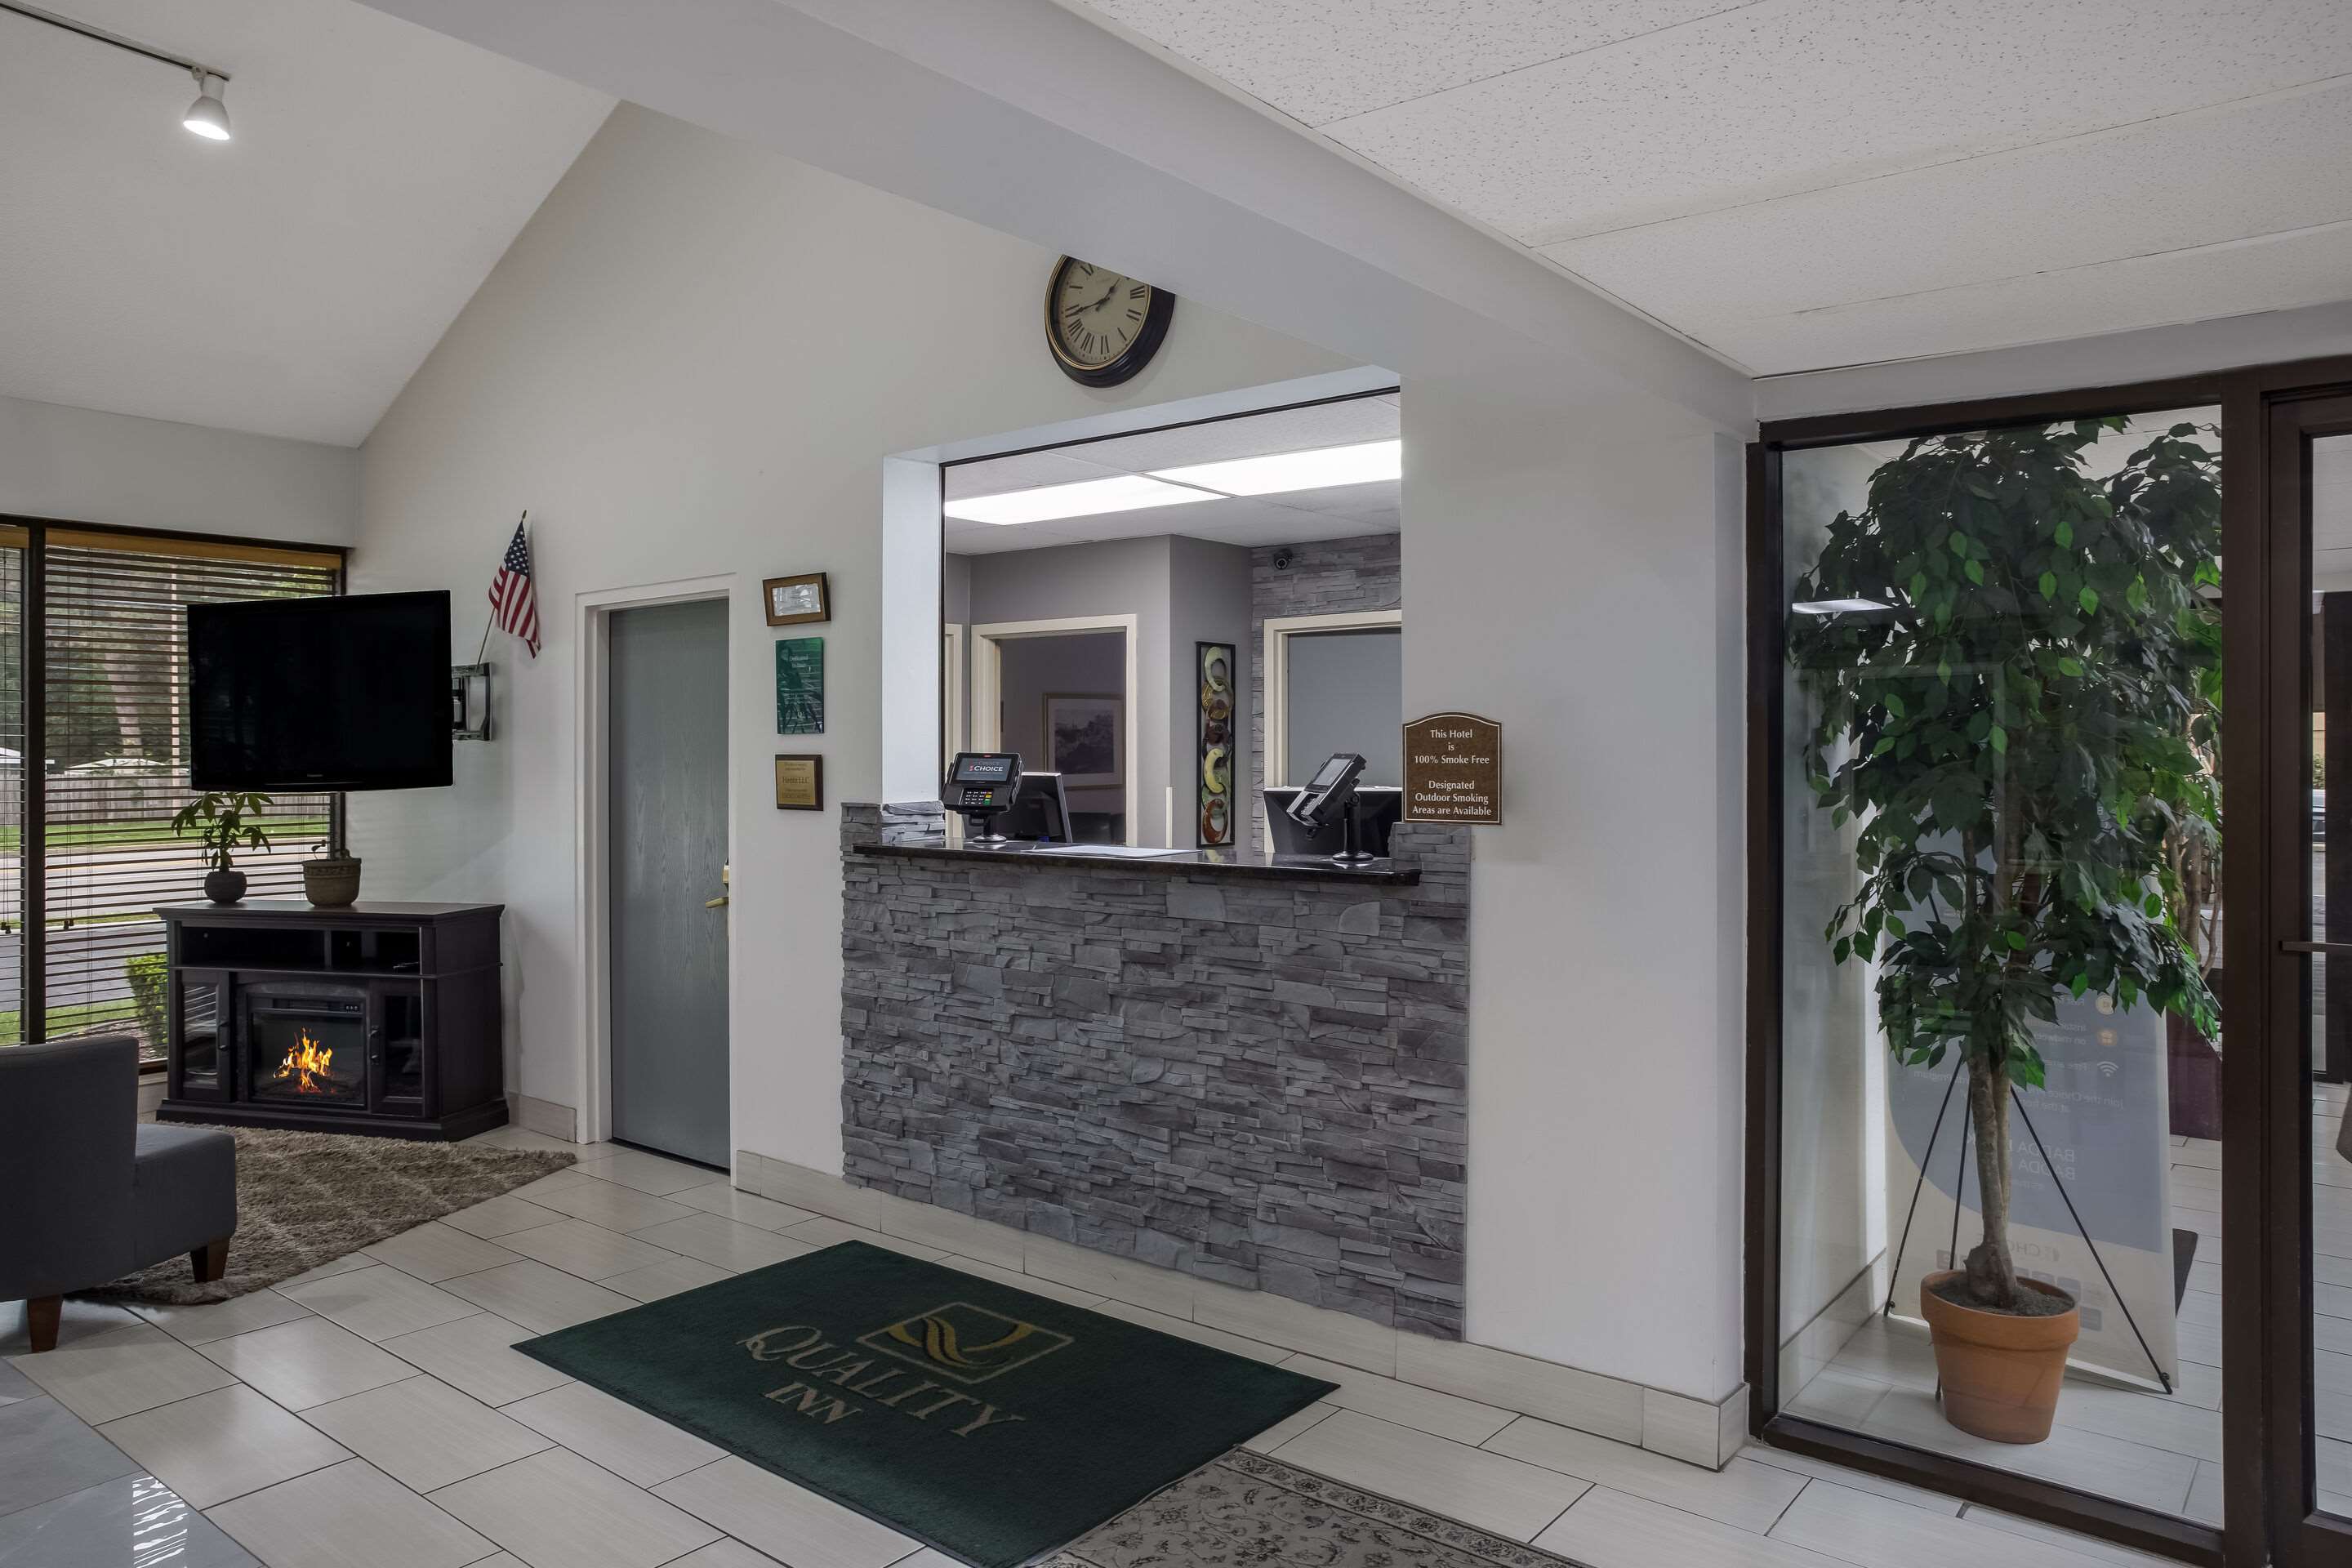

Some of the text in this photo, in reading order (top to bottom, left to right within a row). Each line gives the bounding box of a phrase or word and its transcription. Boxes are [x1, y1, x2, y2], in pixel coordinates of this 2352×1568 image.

[1430, 729, 1472, 738] This Hotel
[1448, 742, 1454, 751] is
[1414, 755, 1490, 764] 100% Smoke Free
[1428, 780, 1475, 791] Designated
[1414, 792, 1489, 805] Outdoor Smoking
[1412, 805, 1435, 814] Areas
[1452, 806, 1491, 816] Available
[736, 1325, 1027, 1437] QUALITY
[761, 1381, 863, 1424] INN
